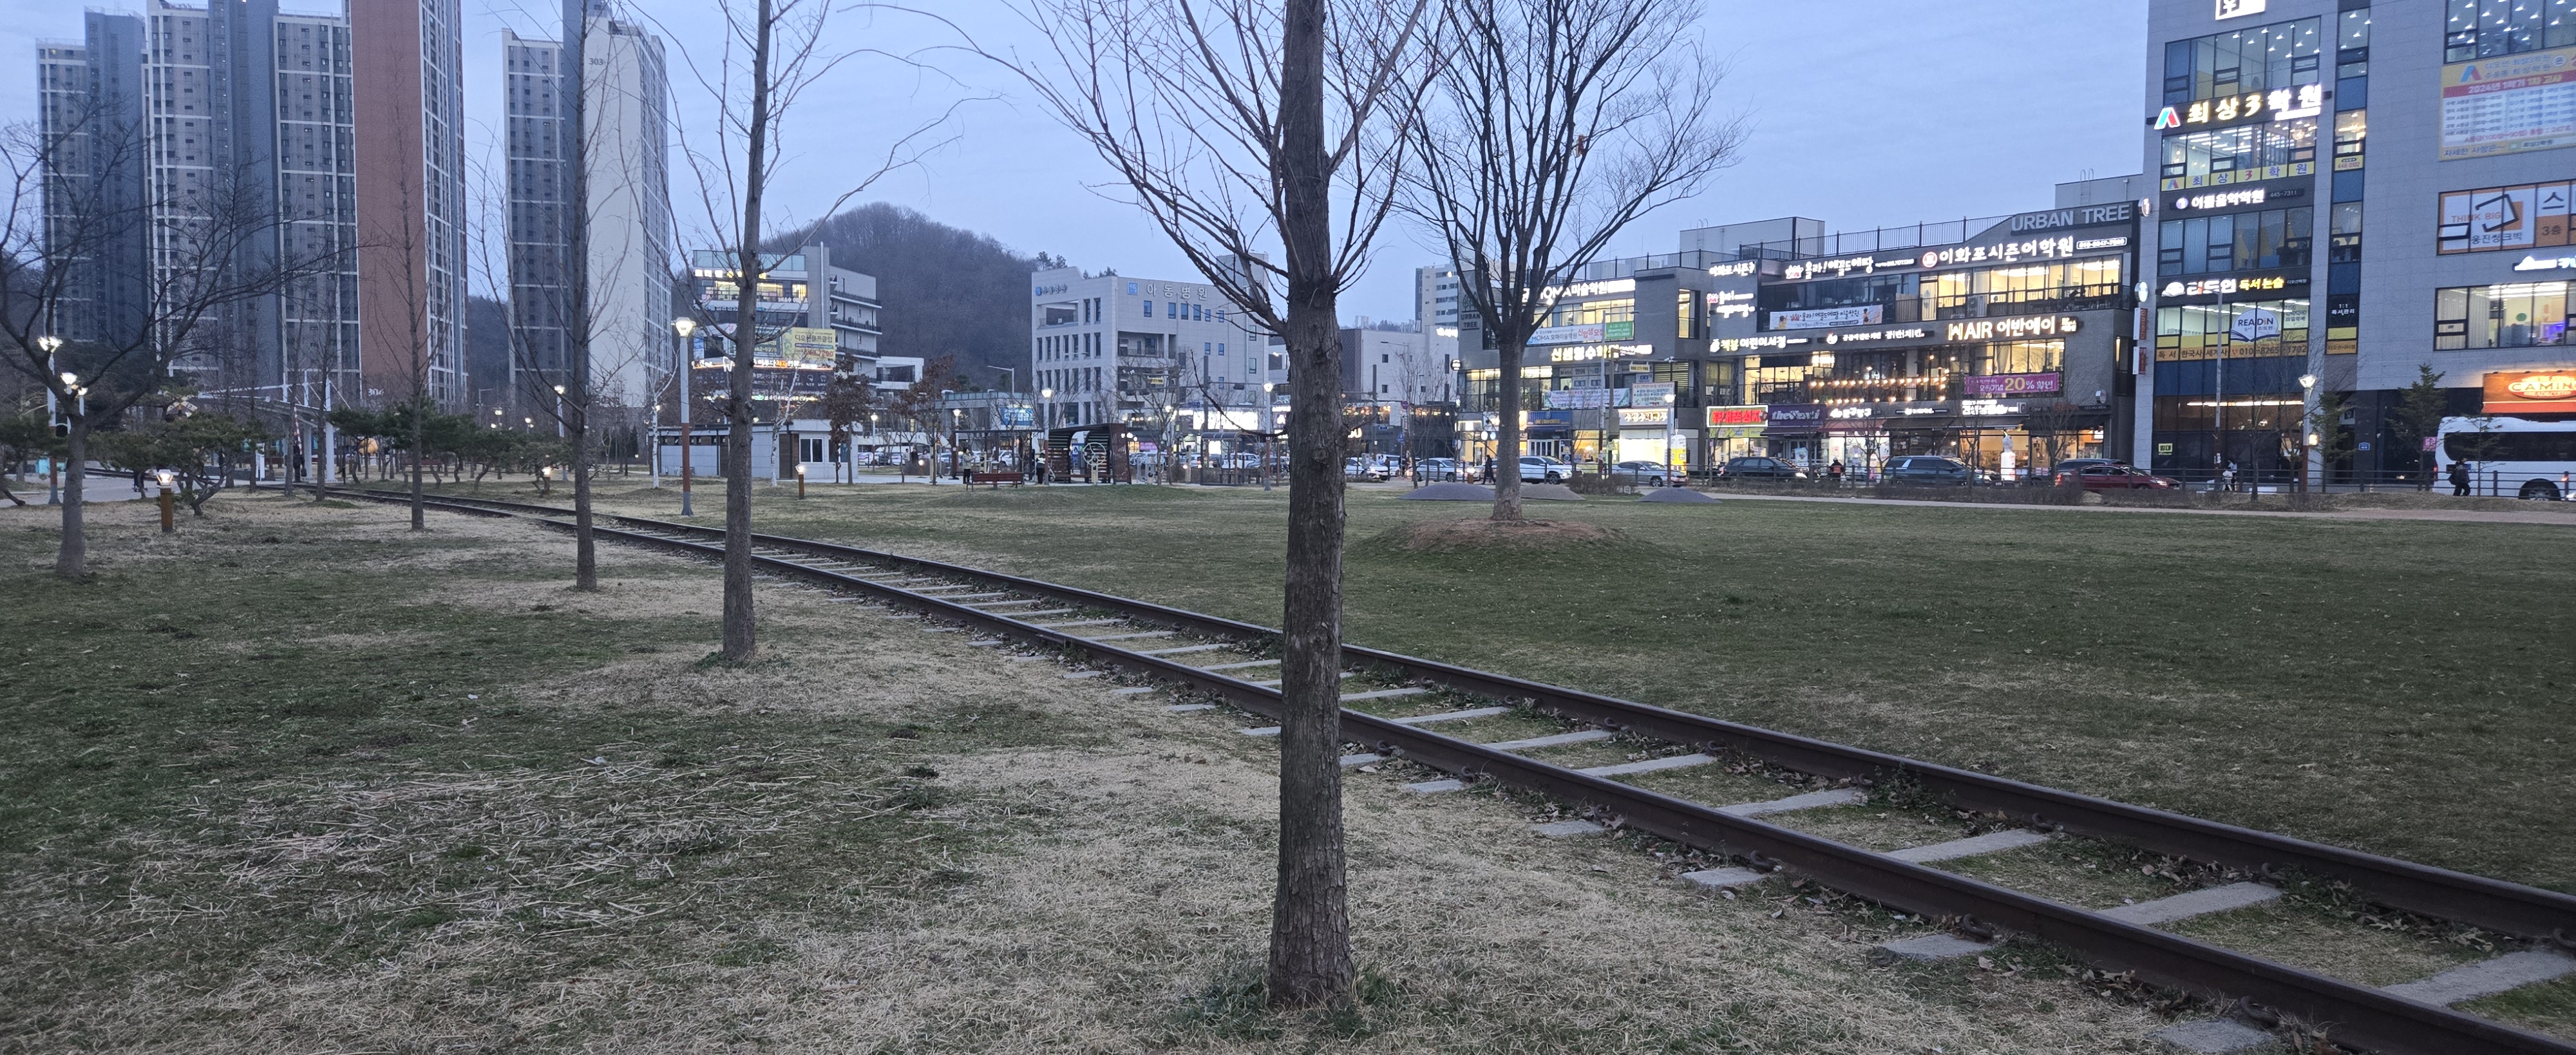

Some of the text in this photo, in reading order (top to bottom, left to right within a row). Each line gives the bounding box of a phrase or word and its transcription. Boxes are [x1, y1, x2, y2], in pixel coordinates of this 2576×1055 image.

[2011, 204, 2130, 231] URBAN TREE
[2451, 211, 2501, 223] THINK BIG
[1147, 283, 1207, 301] 아동병원
[2186, 279, 2237, 296] 리드인
[1461, 312, 1481, 321] URBAN
[2181, 350, 2202, 358] 한국사
[2004, 377, 2035, 391] 20%
